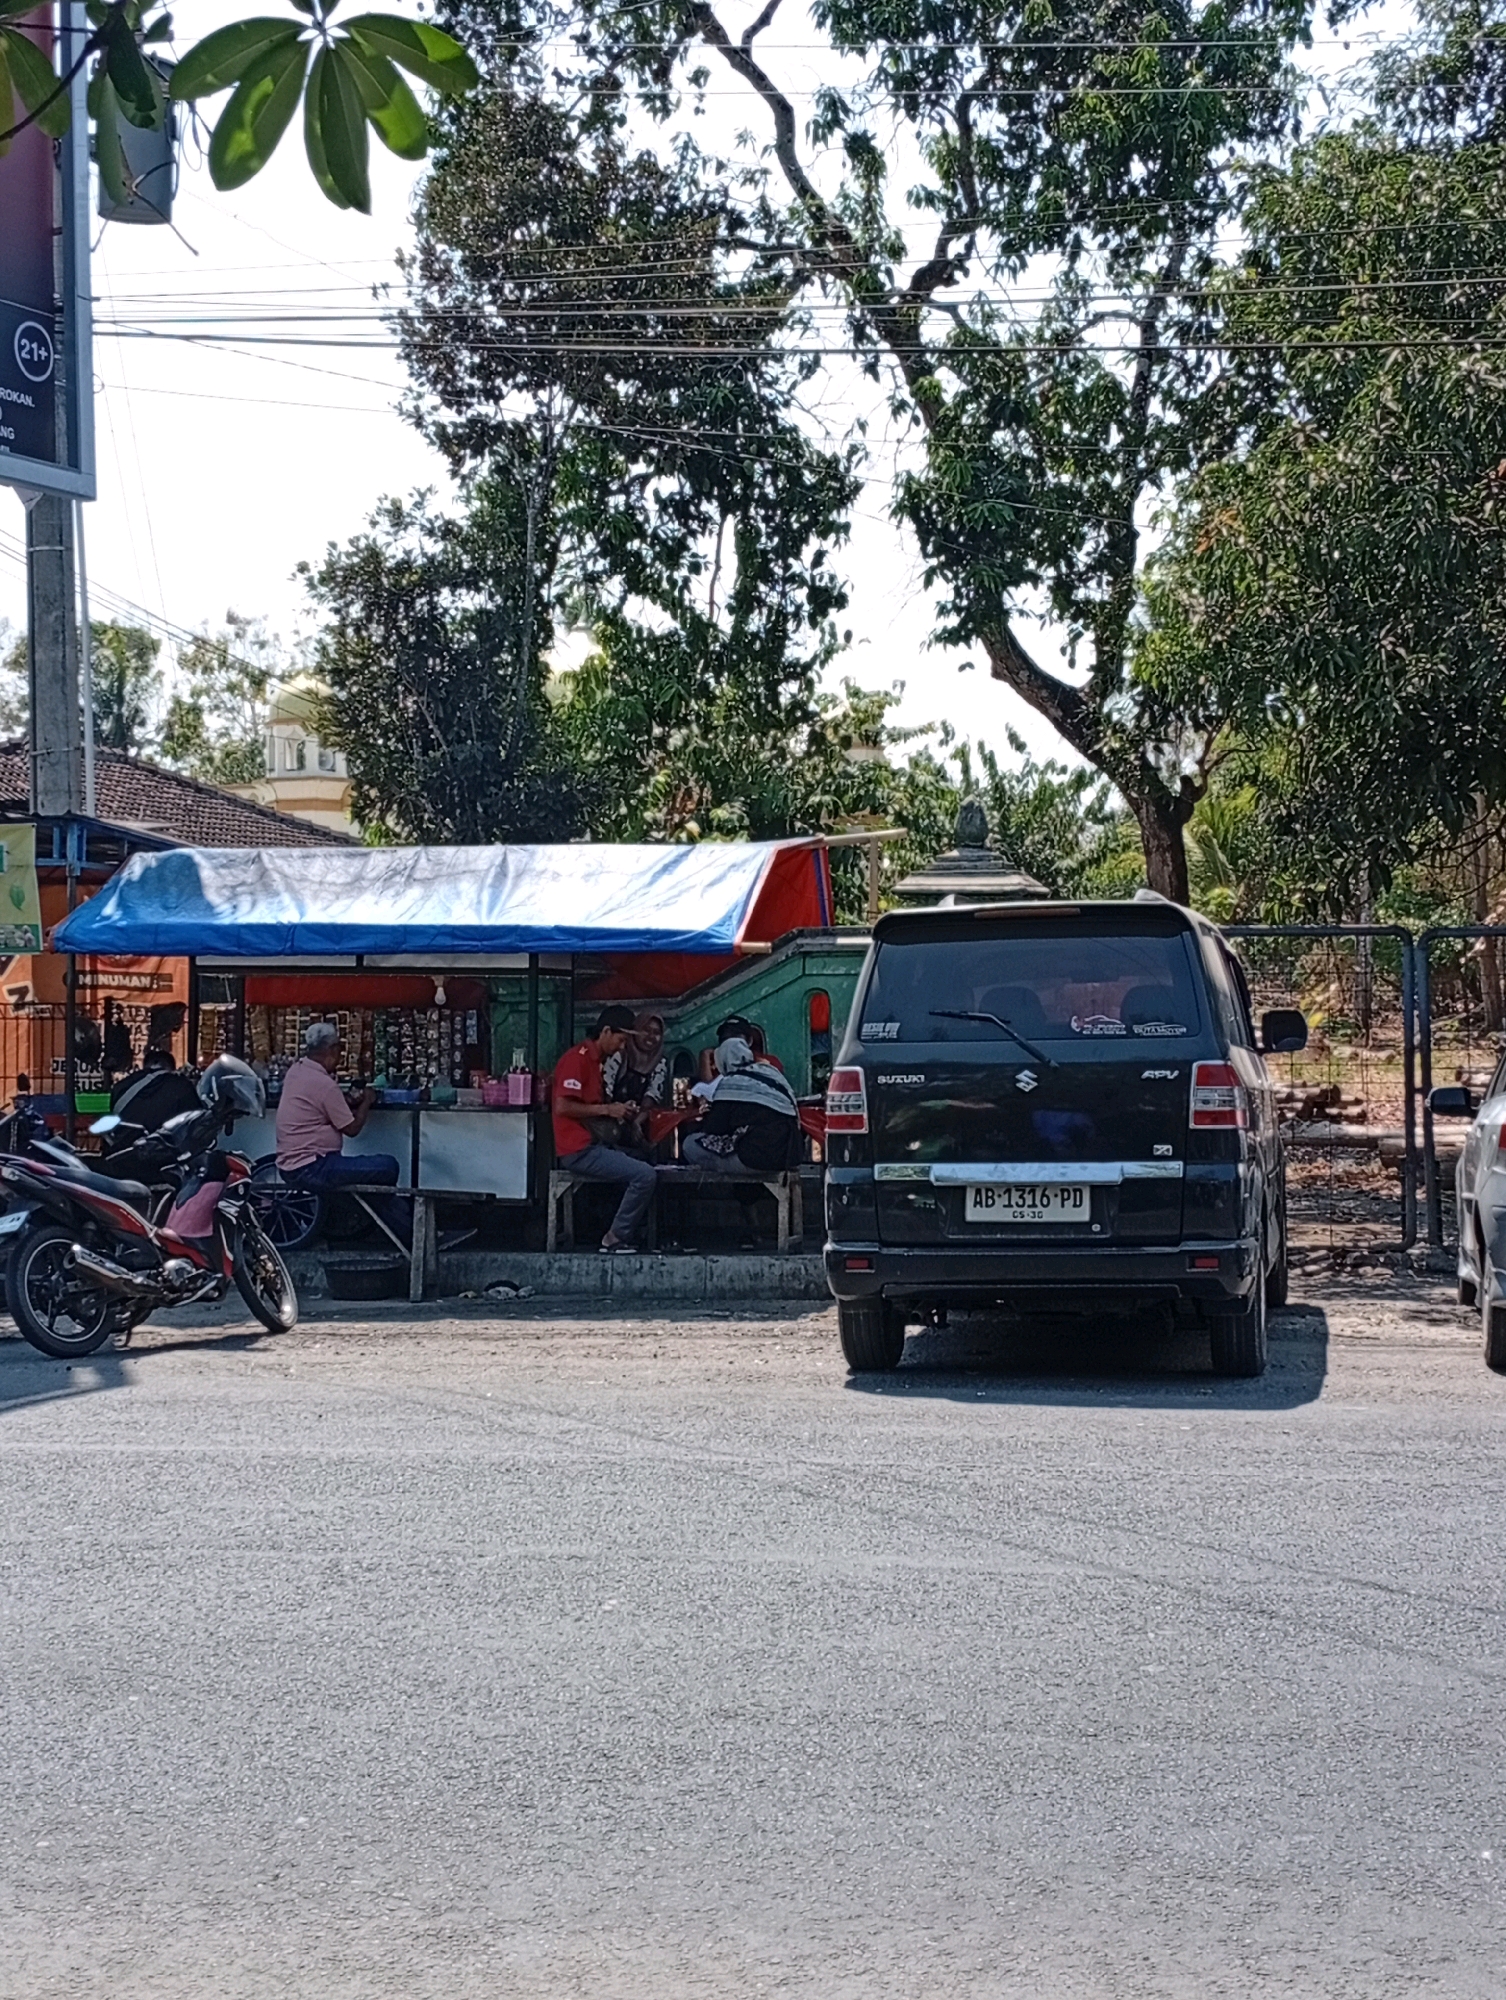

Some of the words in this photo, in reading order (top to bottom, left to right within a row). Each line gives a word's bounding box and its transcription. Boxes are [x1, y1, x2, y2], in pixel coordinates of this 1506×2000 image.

[20, 338, 49, 362] 21+
[78, 974, 151, 988] MINUMAN
[877, 1074, 925, 1084] SUZUKI
[1141, 1070, 1179, 1079] APV
